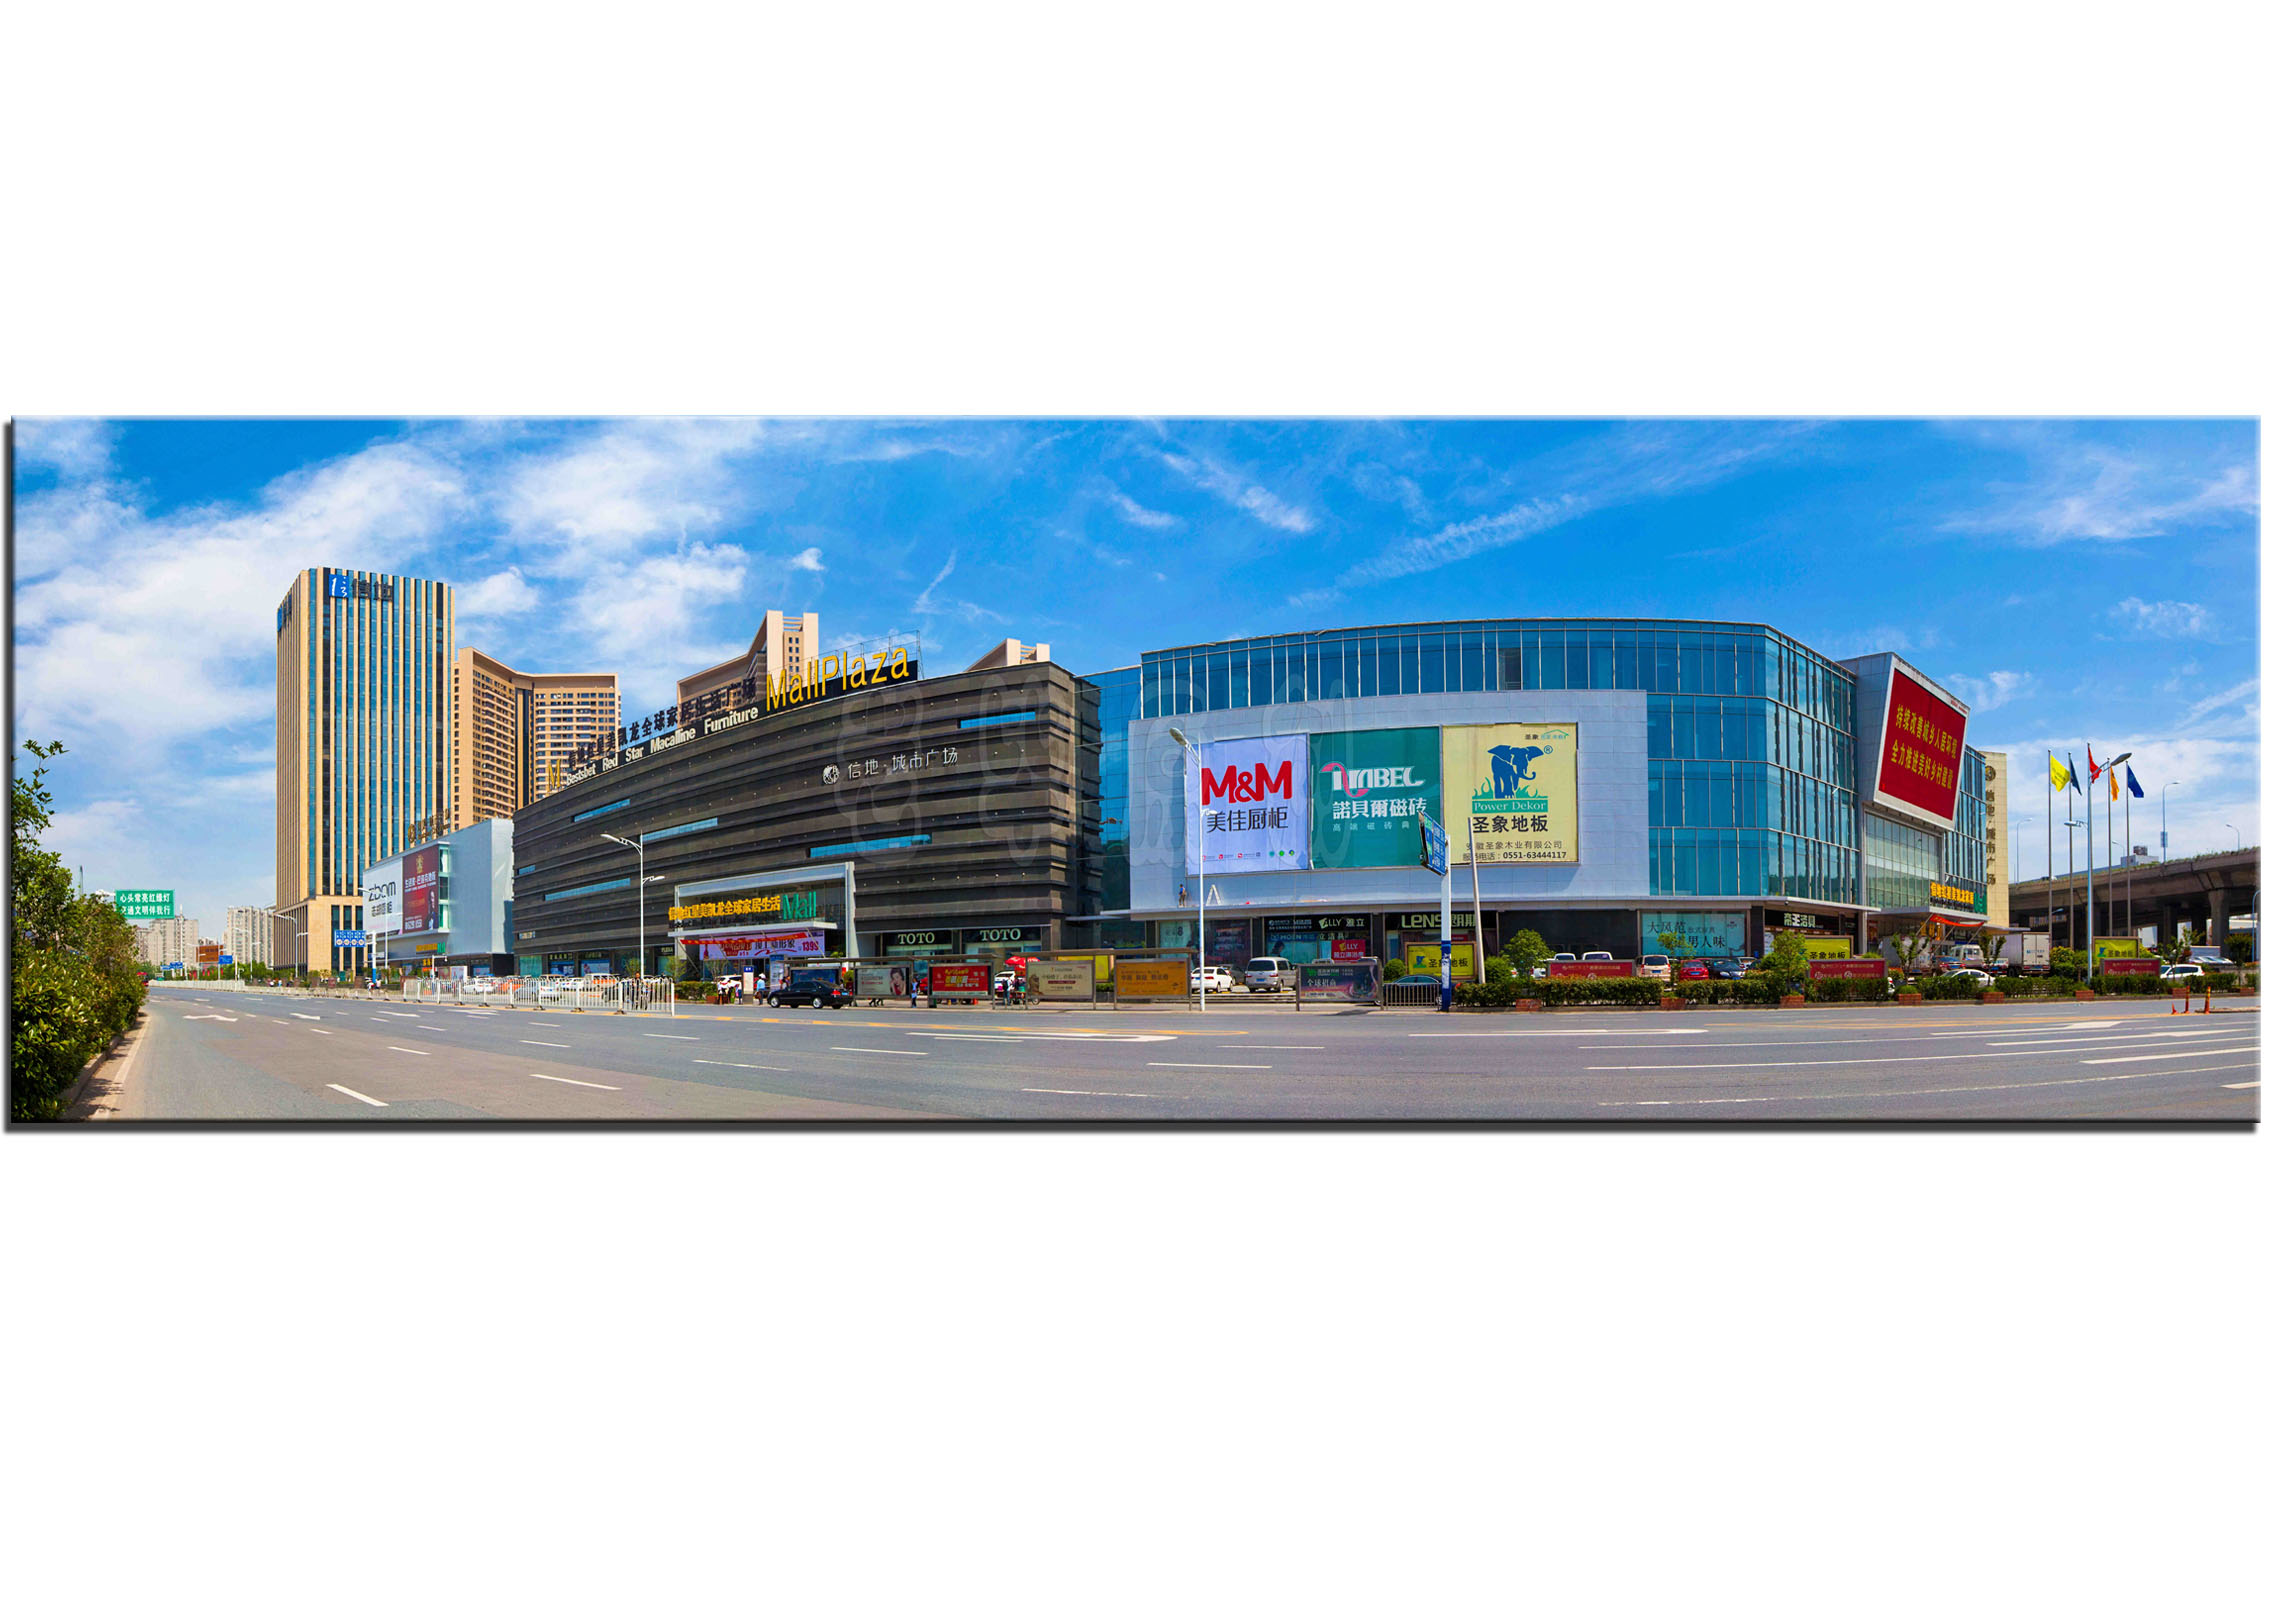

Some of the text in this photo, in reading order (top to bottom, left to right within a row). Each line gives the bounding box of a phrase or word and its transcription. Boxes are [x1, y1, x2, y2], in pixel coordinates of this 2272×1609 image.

[766, 648, 909, 712] MallPlaza
[603, 752, 619, 771] Red
[625, 747, 644, 762] Star
[650, 726, 696, 753] Macalline
[704, 707, 759, 734] Furniture
[1202, 760, 1292, 806] M&M
[1474, 801, 1546, 811] Power Dekor
[1207, 806, 1288, 834] 美佳厨柜
[1472, 815, 1548, 833] 圣象地板
[1503, 851, 1567, 860] 0551-63444117
[782, 891, 816, 919] Mall
[898, 932, 935, 944] TOTO
[980, 928, 1021, 941] TOTO
[1429, 958, 1468, 968] 圣地板
